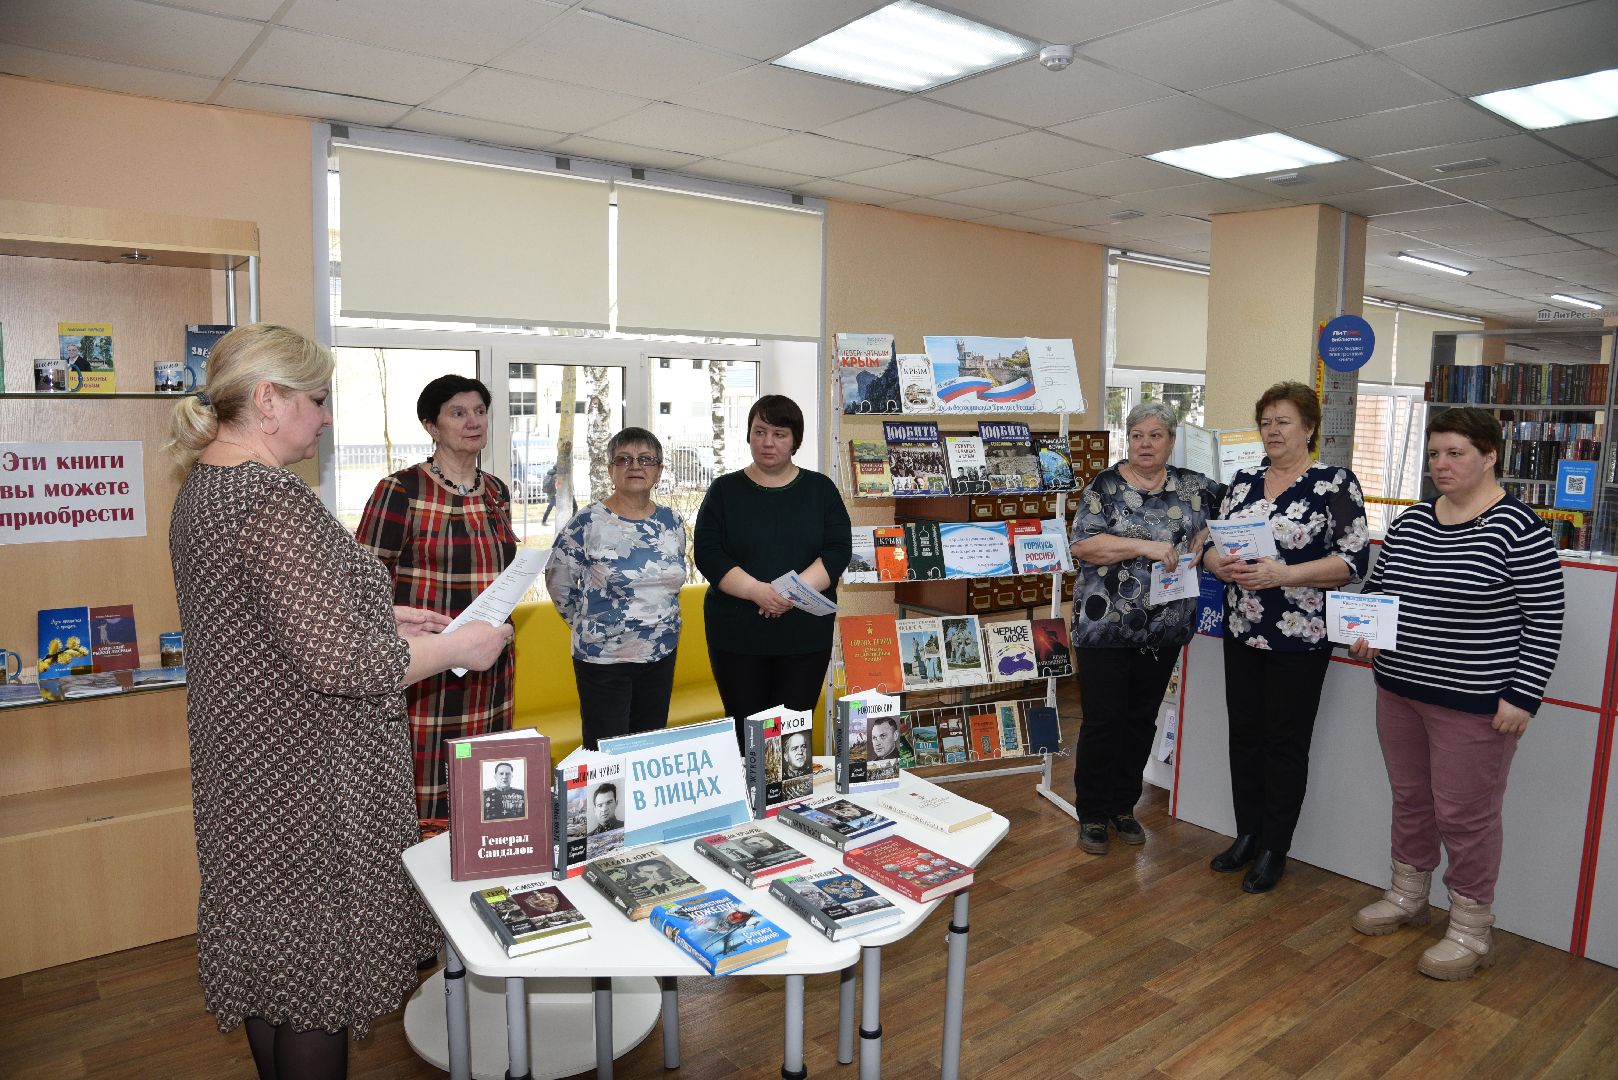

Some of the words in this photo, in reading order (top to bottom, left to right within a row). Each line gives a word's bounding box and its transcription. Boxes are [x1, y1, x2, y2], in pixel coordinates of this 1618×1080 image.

[841, 356, 881, 369] КРЫМ
[903, 367, 929, 375] КРЫМ
[3, 451, 46, 472] Эти
[57, 455, 124, 471] книги
[0, 483, 35, 500] вы
[44, 480, 130, 499] можете
[0, 506, 135, 531] приобрести
[879, 537, 903, 546] КРЫМ
[1023, 541, 1054, 551] ГОРЖУСЬ
[1025, 550, 1056, 562] РОССИЕЙ
[993, 625, 1029, 637] ЧЕРНОЕ
[1004, 633, 1029, 644] МОРЕ
[772, 717, 809, 734] ЖУКОВ
[599, 763, 620, 779] ЧУЙКОВ
[632, 749, 719, 782] ПОБЕДА
[632, 789, 647, 811] В
[654, 775, 728, 808] ЛИЦАХ
[480, 833, 530, 847] Генерал
[477, 846, 534, 861] Сандалов
[633, 849, 659, 862] ЗОРГЕ
[486, 888, 513, 898] ГЕРОИ
[687, 901, 739, 920] КОЖЕДУБ
[742, 926, 773, 940] Служу
[746, 931, 780, 947] Родине
